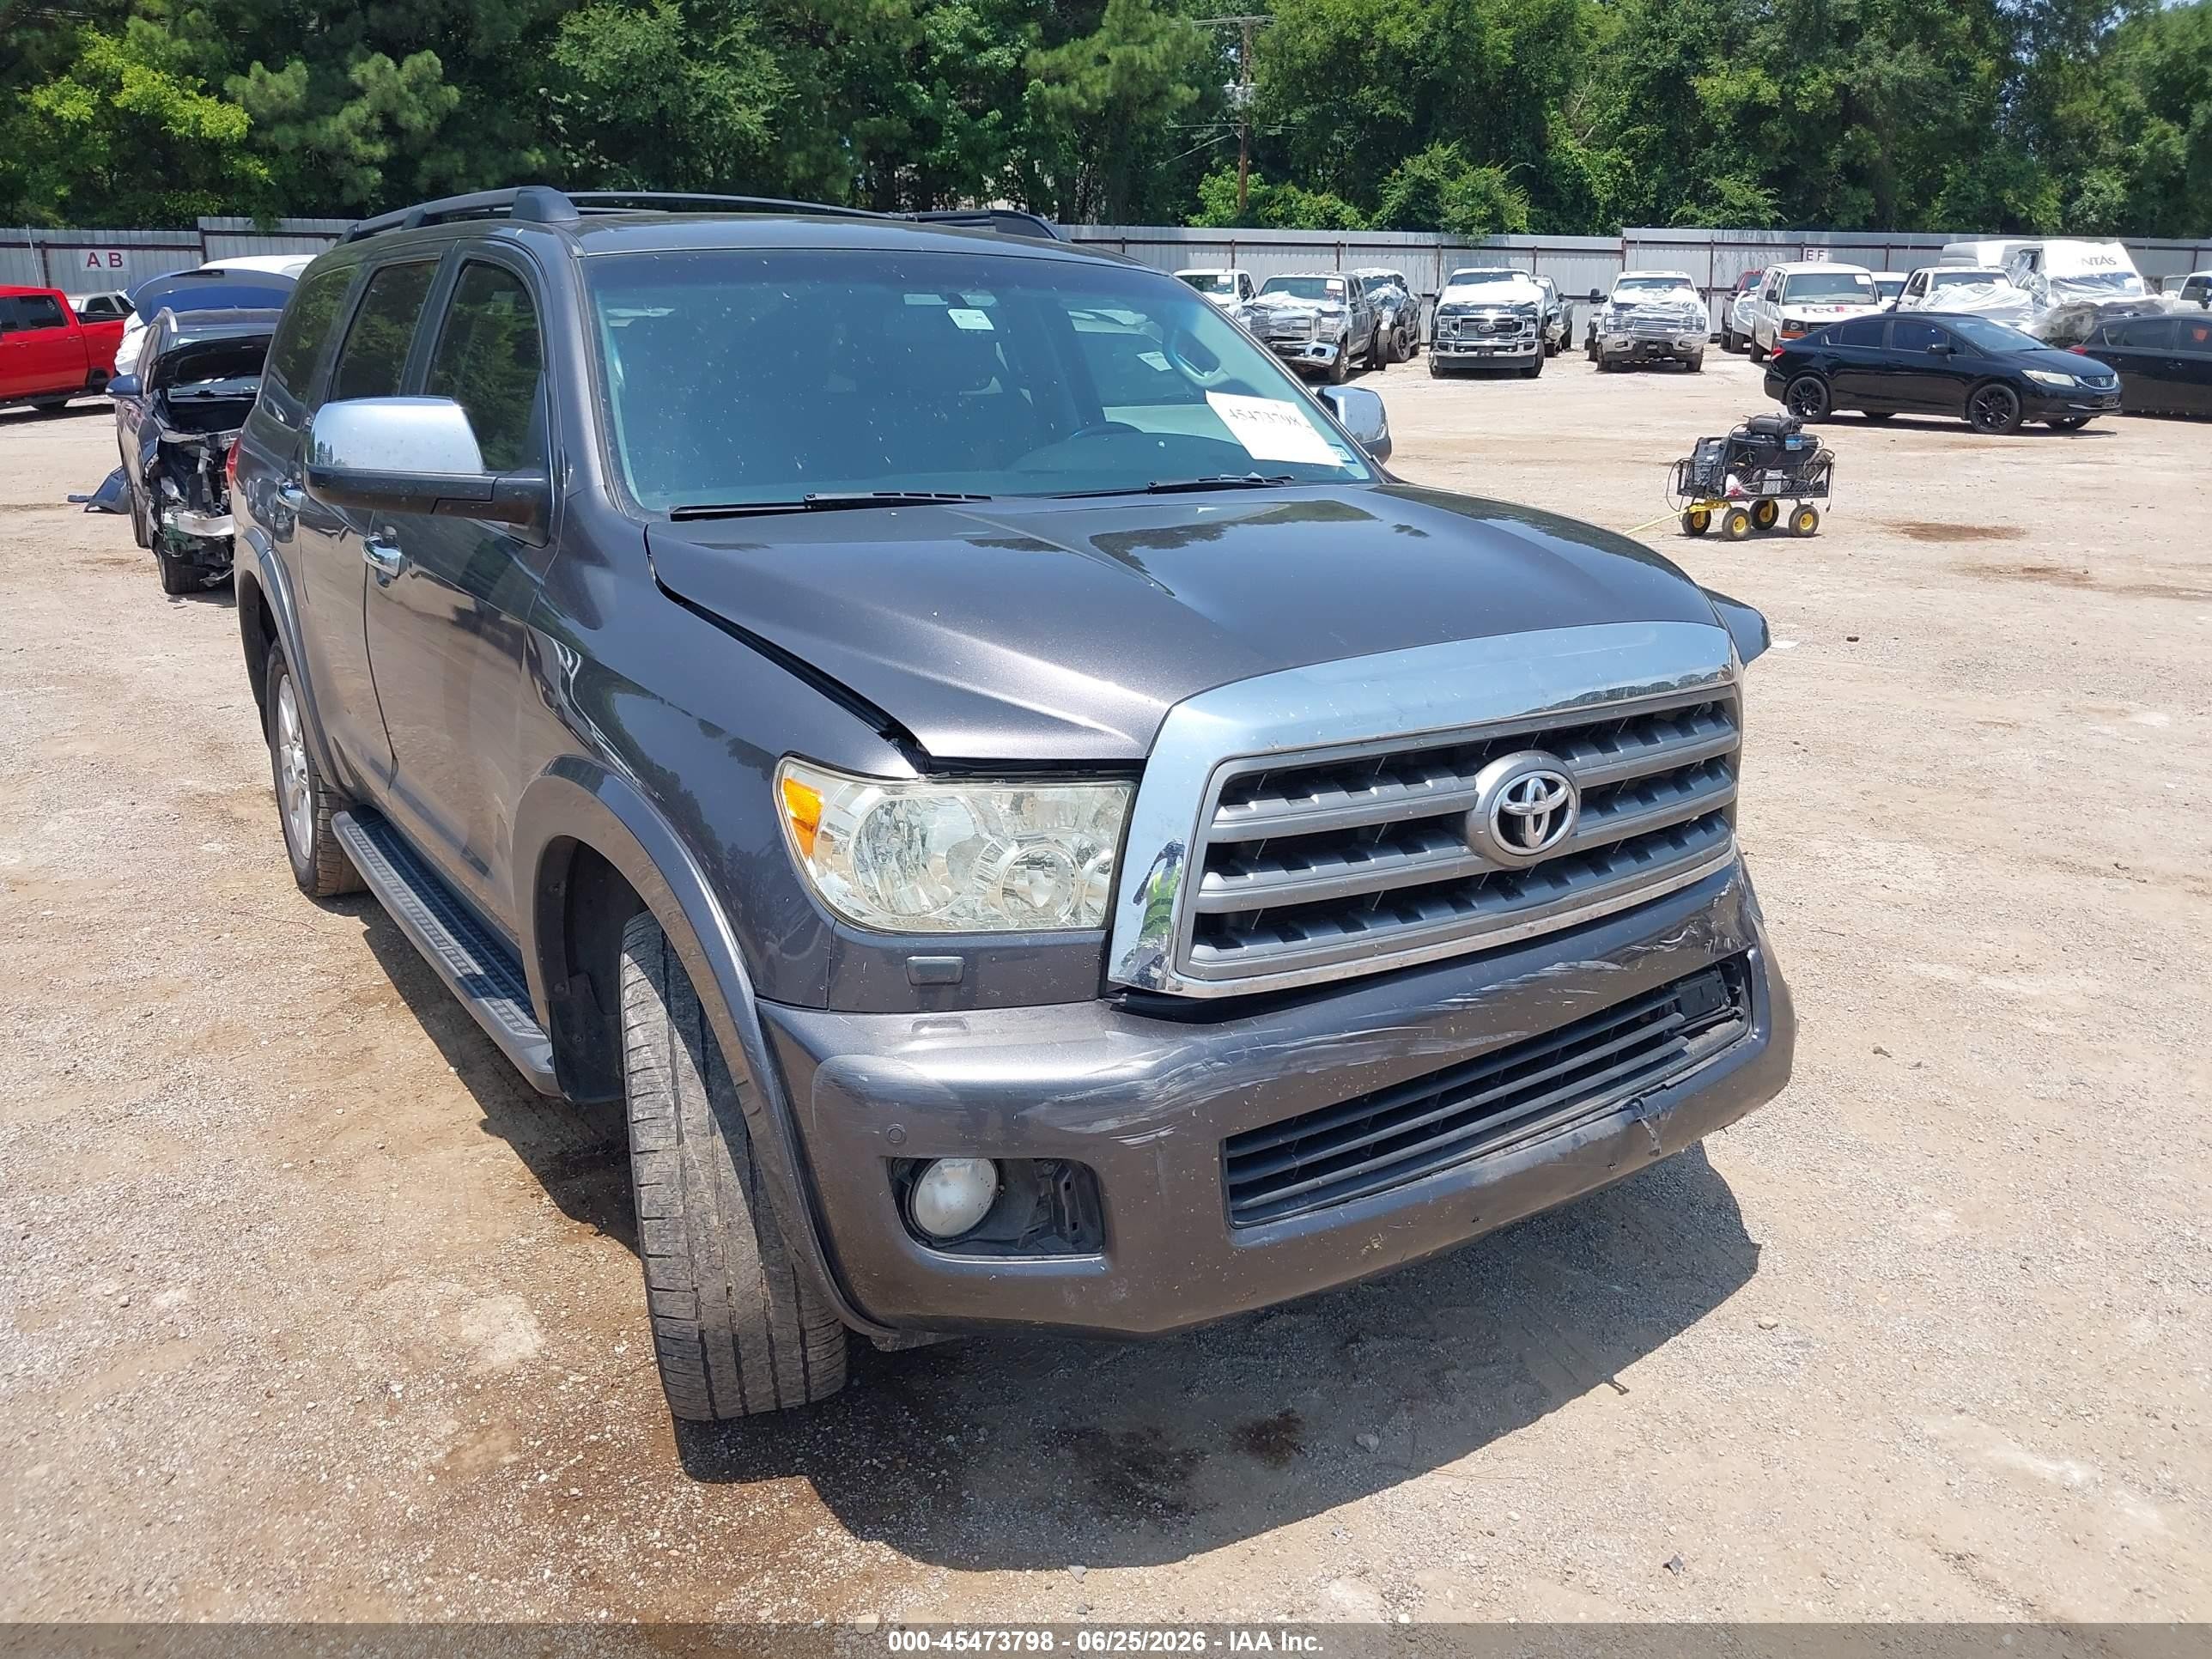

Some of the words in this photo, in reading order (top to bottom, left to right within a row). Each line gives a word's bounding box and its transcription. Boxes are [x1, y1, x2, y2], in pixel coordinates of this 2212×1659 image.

[87, 252, 101, 267] A
[108, 252, 123, 267] B
[2075, 255, 2117, 265] NTAS
